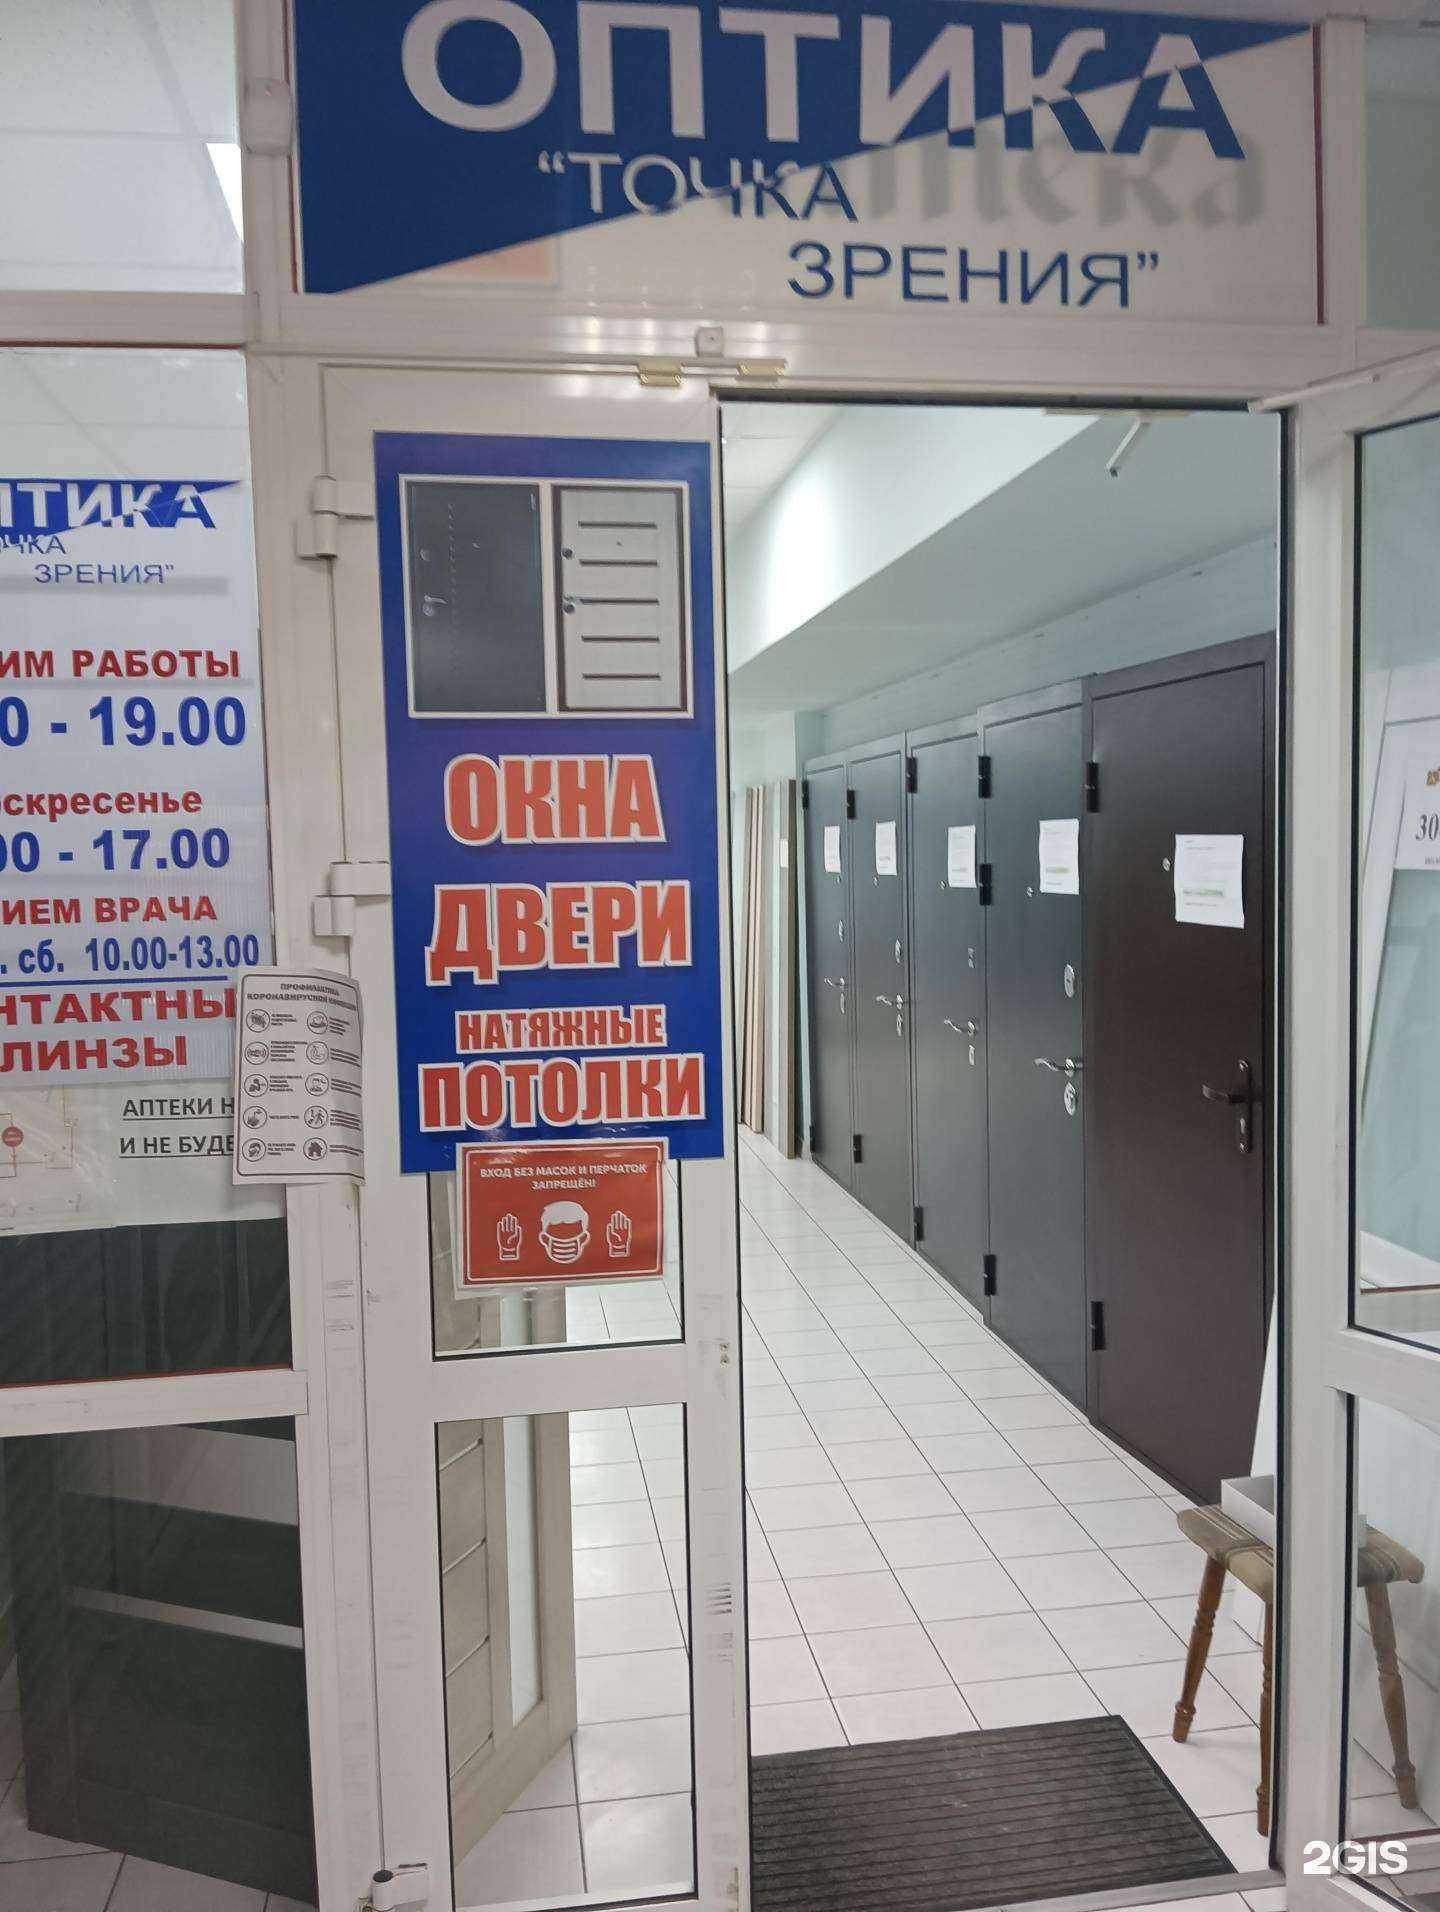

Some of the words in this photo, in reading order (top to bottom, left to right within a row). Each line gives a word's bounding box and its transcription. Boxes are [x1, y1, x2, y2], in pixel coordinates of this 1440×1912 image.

[402, 0, 1246, 160] ОПТИКА
[0, 482, 217, 530] ТИКА
[0, 534, 67, 555] ЧКА
[72, 649, 240, 679] РАБОТЫ
[89, 695, 246, 747] 19.00
[0, 791, 204, 823] скресенье
[444, 753, 668, 846] ОКНА
[0, 831, 40, 873] 0
[93, 827, 230, 870] 17.00
[95, 896, 218, 925] ВРАЧА
[18, 938, 65, 974] сб.
[85, 933, 260, 973] 10.00-13.00
[424, 879, 693, 987] ДВЕРИ
[455, 1003, 668, 1055] НАТЯЖНЫЕ
[0, 1035, 188, 1074] ЛИНЗЫ
[122, 1097, 213, 1117] АПТЕКИ
[417, 1052, 706, 1133] ПОТОЛКИ
[119, 1137, 136, 1154] И
[143, 1136, 171, 1154] НЕ
[480, 1168, 512, 1179] ВХОД
[514, 1167, 534, 1177] БЕЗ
[535, 1165, 577, 1176] МАСОК
[578, 1165, 588, 1175] И
[589, 1162, 648, 1175] ПЕРЧАТОК
